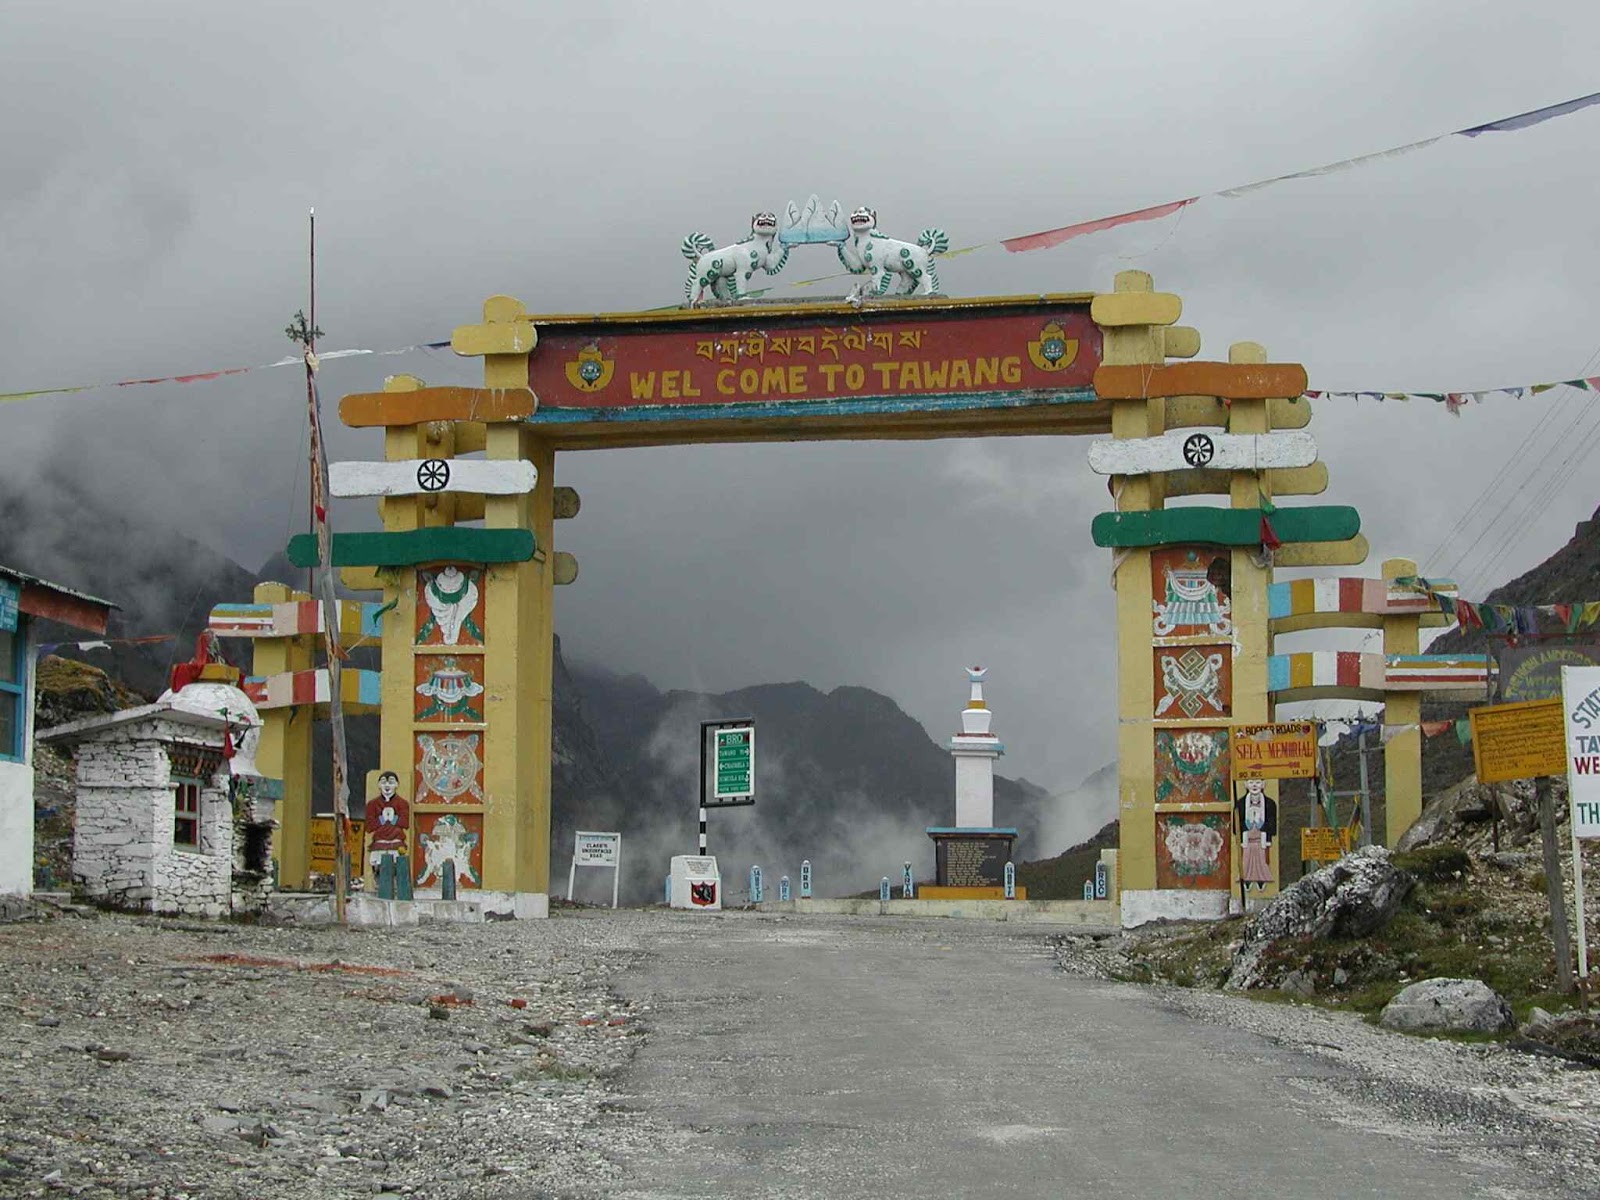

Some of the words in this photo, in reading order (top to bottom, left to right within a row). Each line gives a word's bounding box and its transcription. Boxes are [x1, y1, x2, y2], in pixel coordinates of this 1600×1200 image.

[629, 370, 700, 399] WEL
[716, 365, 808, 395] COME
[818, 363, 865, 392] TO
[872, 356, 1022, 390] TAWANG
[1571, 686, 1600, 729] STAT
[1276, 724, 1302, 735] ROADS
[726, 734, 743, 745] BRO
[1575, 736, 1600, 753] TA
[1236, 743, 1262, 760] SELA
